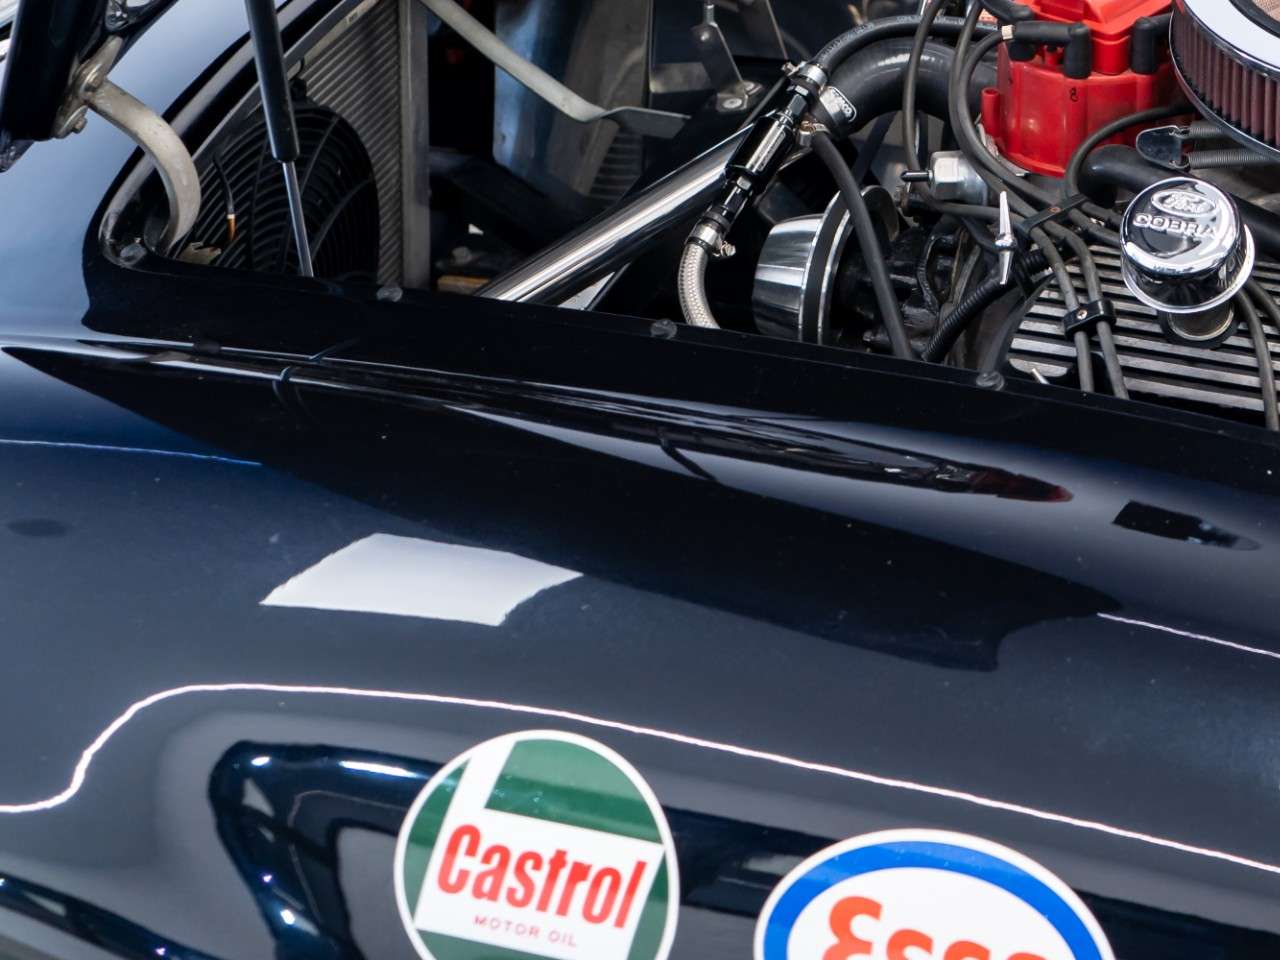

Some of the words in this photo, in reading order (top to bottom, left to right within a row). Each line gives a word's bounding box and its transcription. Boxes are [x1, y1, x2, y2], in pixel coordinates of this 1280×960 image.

[1161, 191, 1214, 215] Ford
[1133, 213, 1218, 242] COBRA
[437, 823, 648, 929] Castrol
[473, 914, 541, 939] MOTOR
[547, 929, 577, 949] OIL
